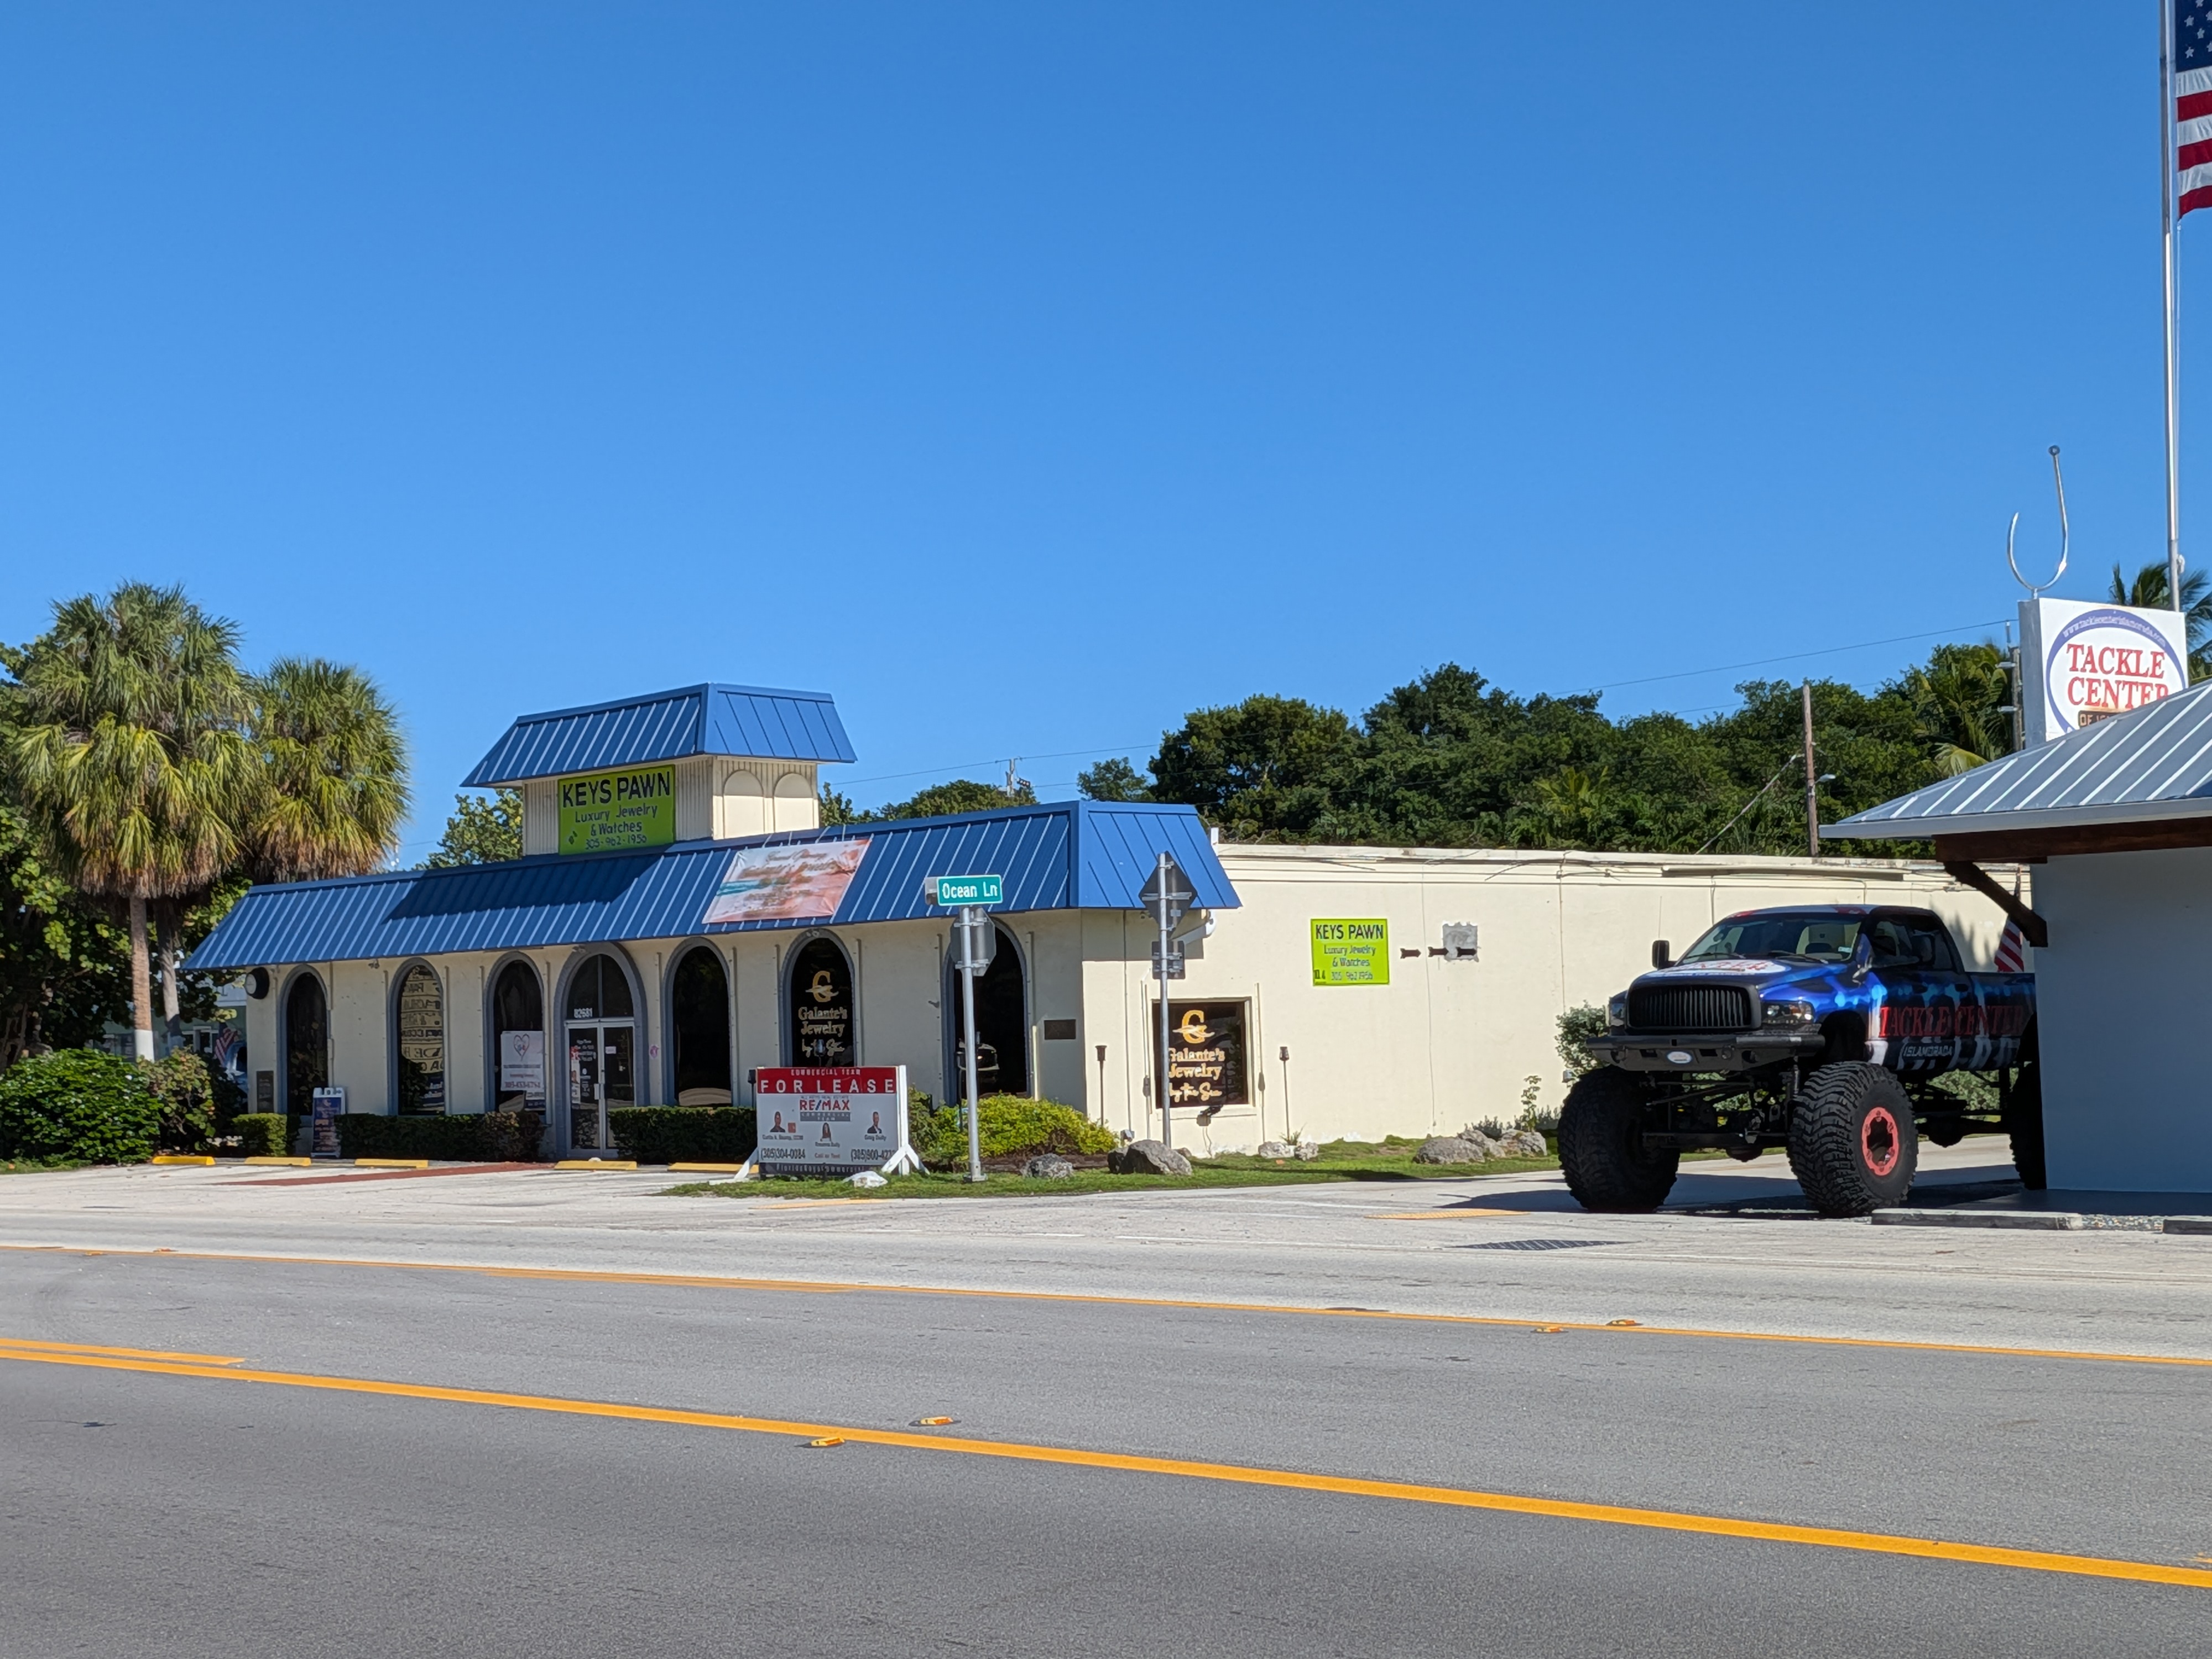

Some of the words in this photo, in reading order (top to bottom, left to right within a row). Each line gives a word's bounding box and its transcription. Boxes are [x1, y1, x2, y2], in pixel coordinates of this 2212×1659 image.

[2066, 644, 2165, 679] TACKLE
[563, 779, 612, 807] KEYS
[617, 771, 670, 801] PAWN
[575, 811, 610, 823] Luxury
[616, 803, 658, 818] Jewelry
[591, 823, 597, 836] &
[599, 822, 642, 835] Watches
[942, 883, 977, 899] Ocean
[983, 881, 998, 897] Ln
[1316, 924, 1344, 940] KEYS
[1348, 924, 1384, 940] PAWN
[1324, 945, 1347, 956] Luxury
[1349, 945, 1376, 956] Jewelry
[1339, 957, 1370, 967] Watches
[798, 1006, 847, 1020] Galante's
[801, 1021, 845, 1037] Jewelry
[1879, 1005, 1950, 1038] TACKLE
[1168, 1047, 1225, 1062] Galante's
[1168, 1063, 1222, 1080] Jewelry
[761, 1080, 802, 1093] FOR
[817, 1079, 894, 1093] LEASE
[800, 1099, 849, 1111] RE/MAX
